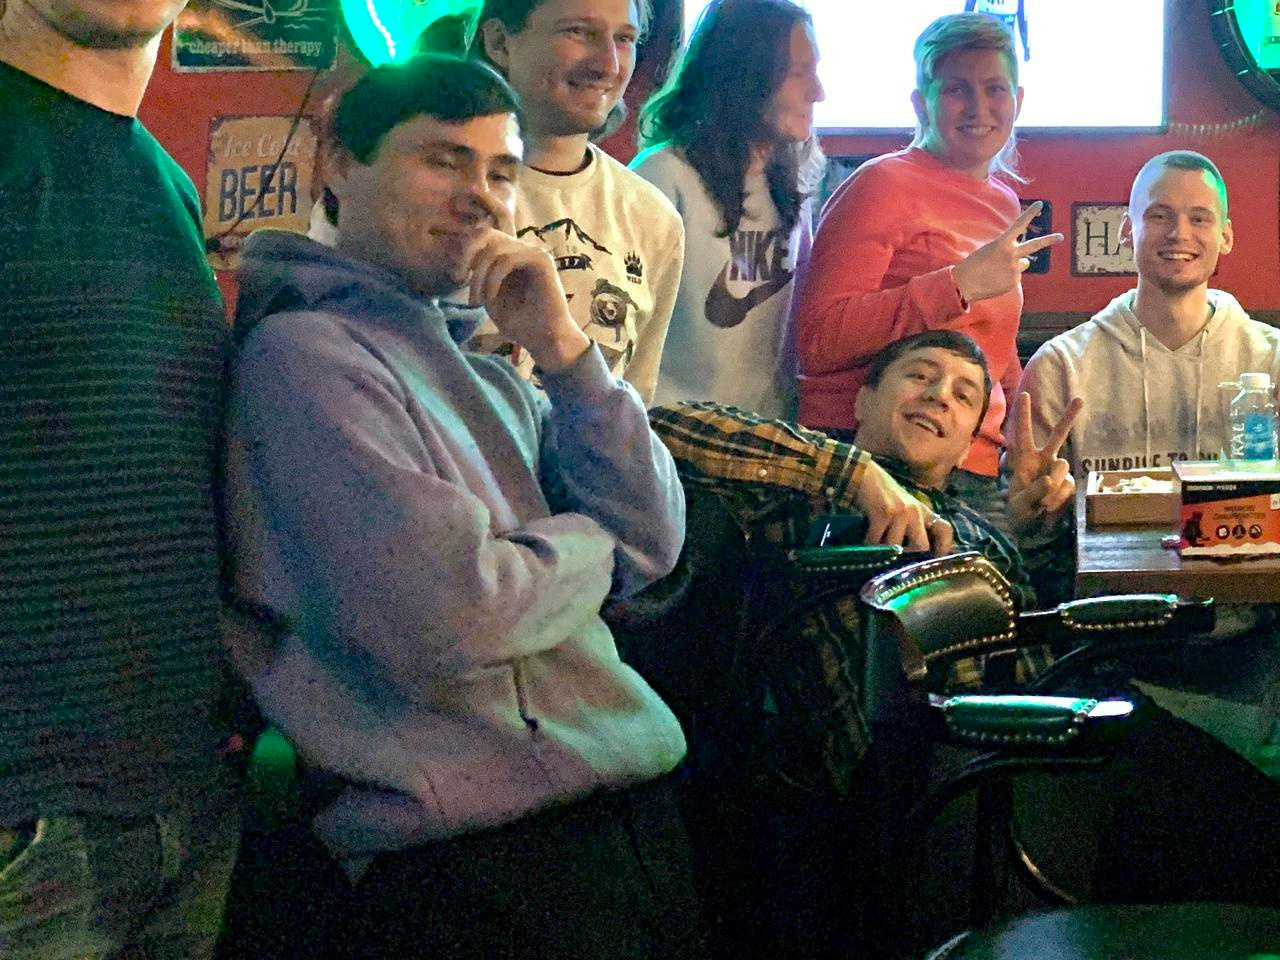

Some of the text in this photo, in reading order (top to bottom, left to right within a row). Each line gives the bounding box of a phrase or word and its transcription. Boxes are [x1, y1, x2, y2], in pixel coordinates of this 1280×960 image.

[189, 39, 240, 56] cheaper
[274, 38, 322, 56] therapy
[219, 161, 297, 222] BEER
